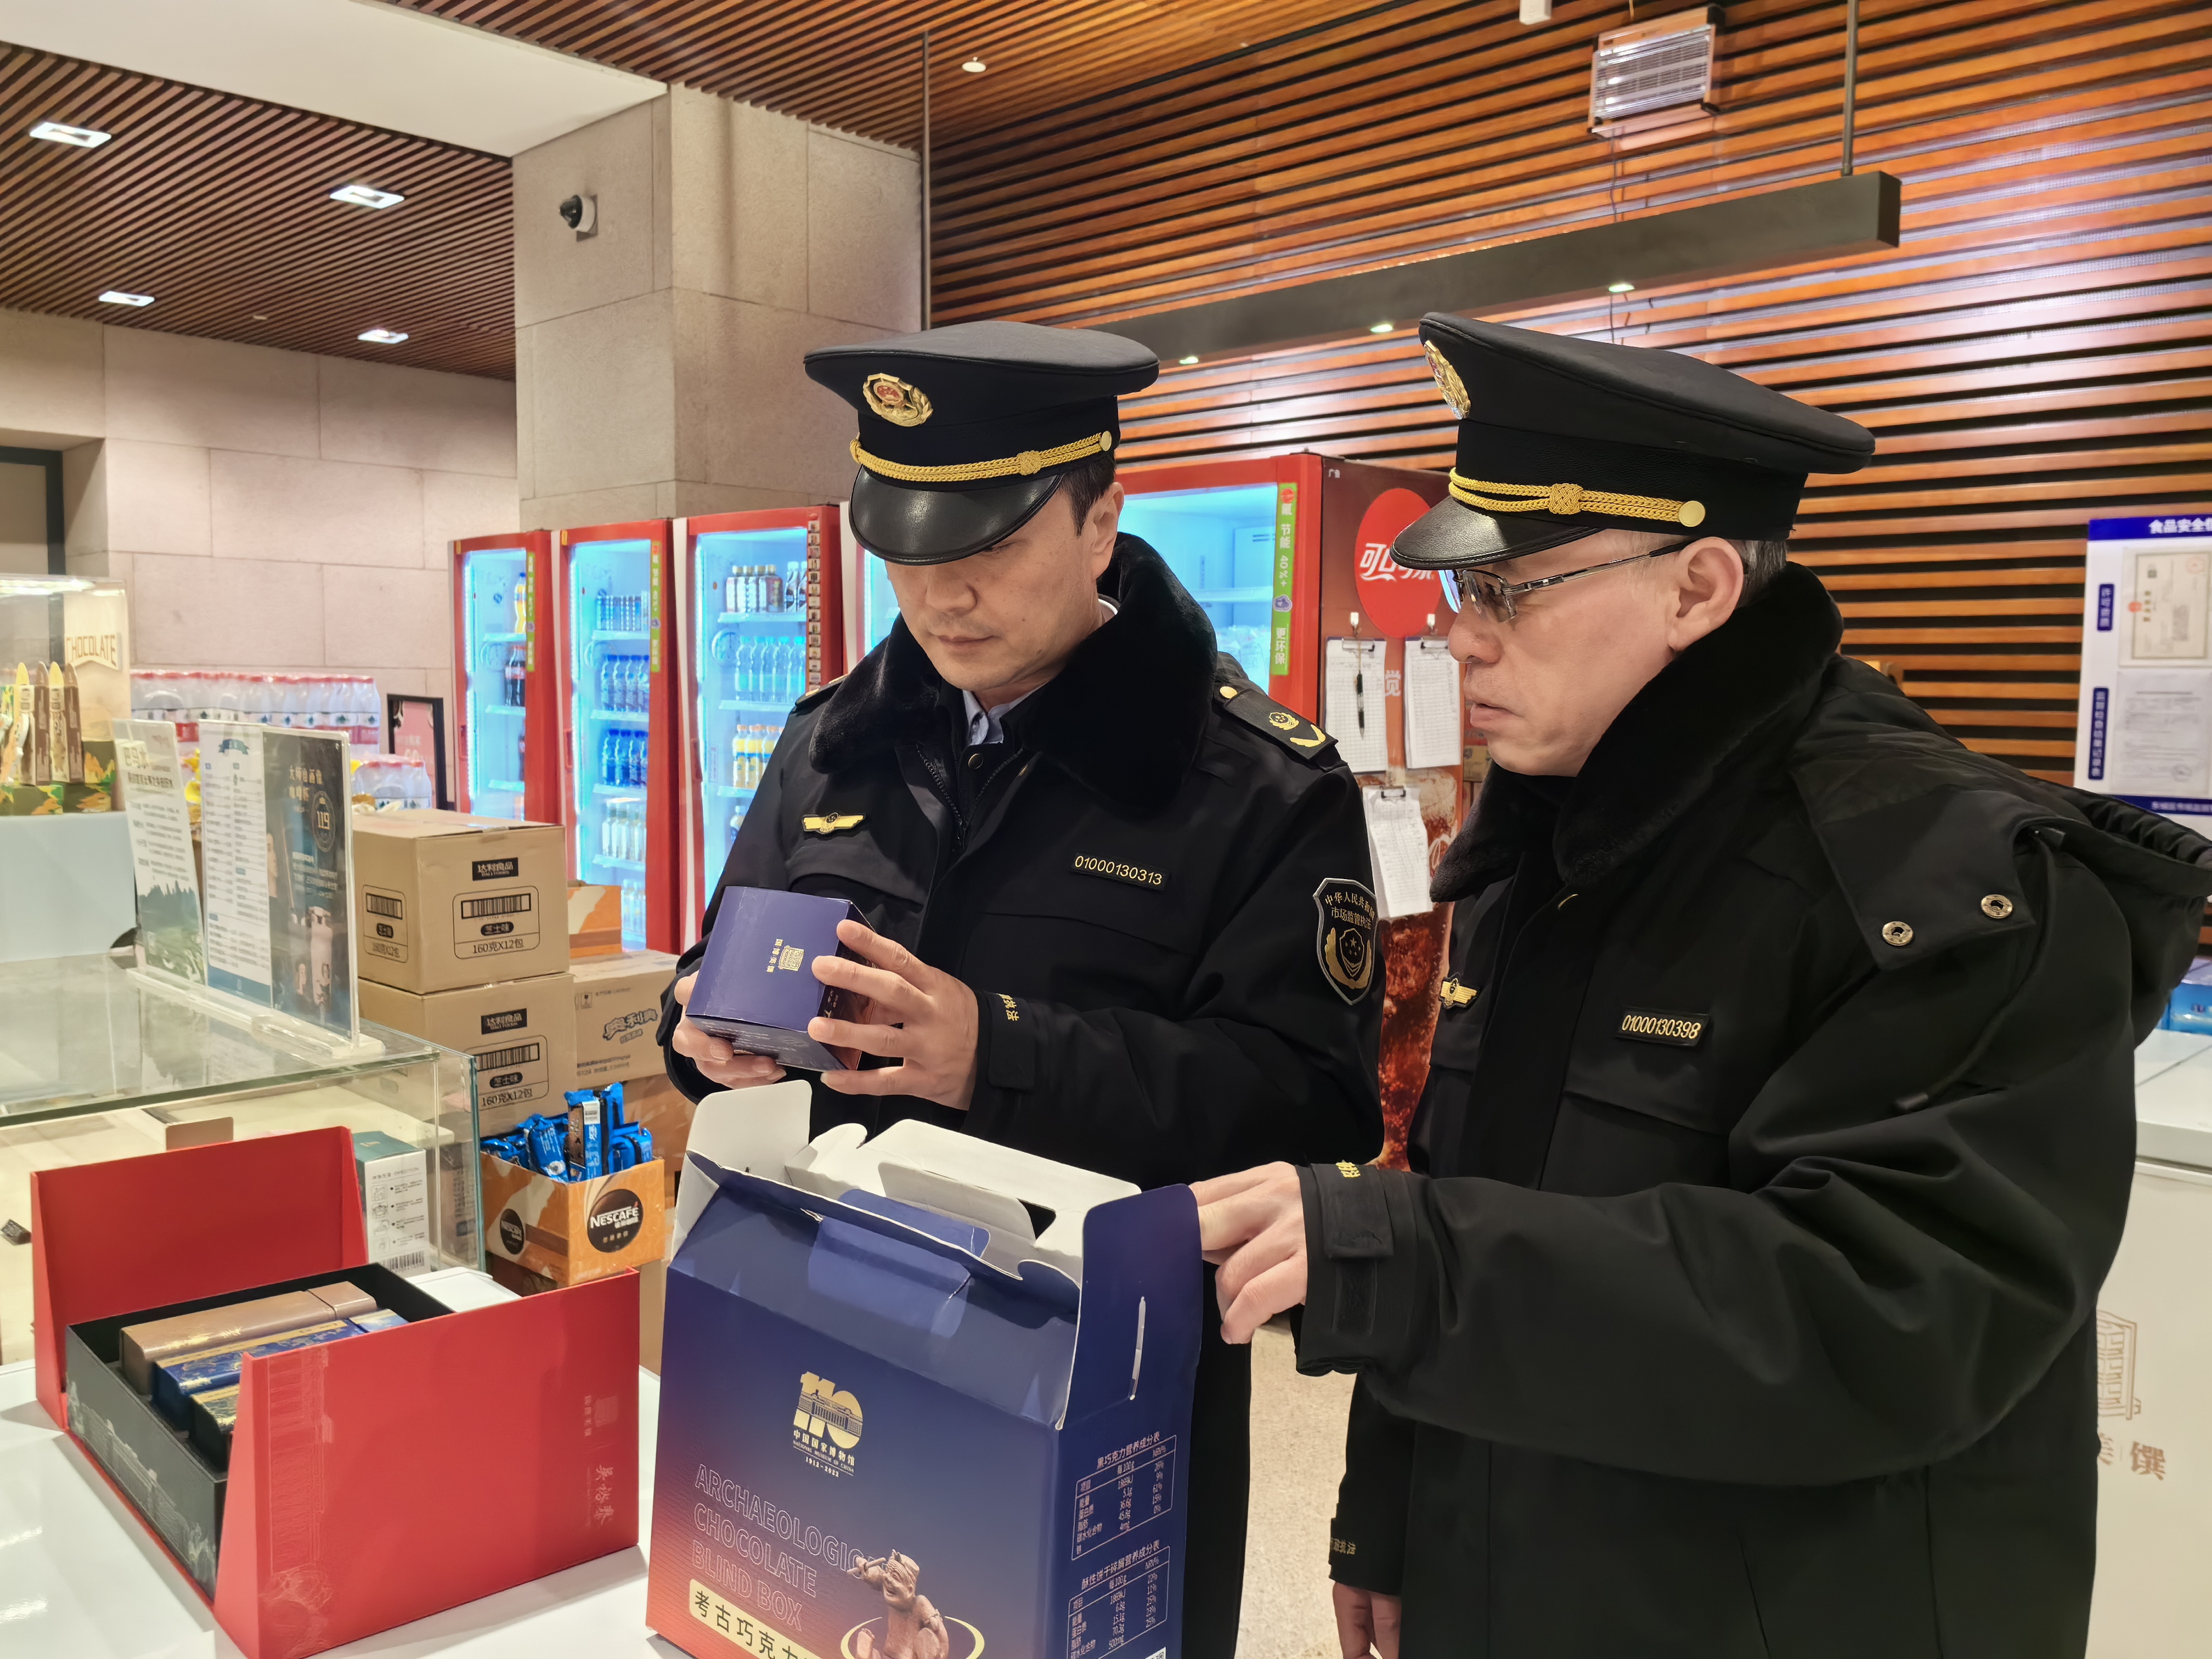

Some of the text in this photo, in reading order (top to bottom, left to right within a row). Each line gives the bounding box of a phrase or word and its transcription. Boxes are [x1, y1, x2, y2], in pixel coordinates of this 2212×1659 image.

[66, 635, 117, 667] CHOCOLATE
[1275, 628, 1286, 665] 更环保
[1075, 856, 1162, 885] 01000130313
[1325, 892, 1375, 920] 中华人民共和国
[1331, 907, 1372, 930] 市场监管执法
[1622, 1015, 1702, 1039] 01000130398
[793, 1429, 855, 1466] 中国国家博物馆
[694, 1464, 887, 1579] ARCHAEOLOGIC
[694, 1503, 817, 1598] CHOCOLATE
[692, 1540, 802, 1631] BLIND BOX
